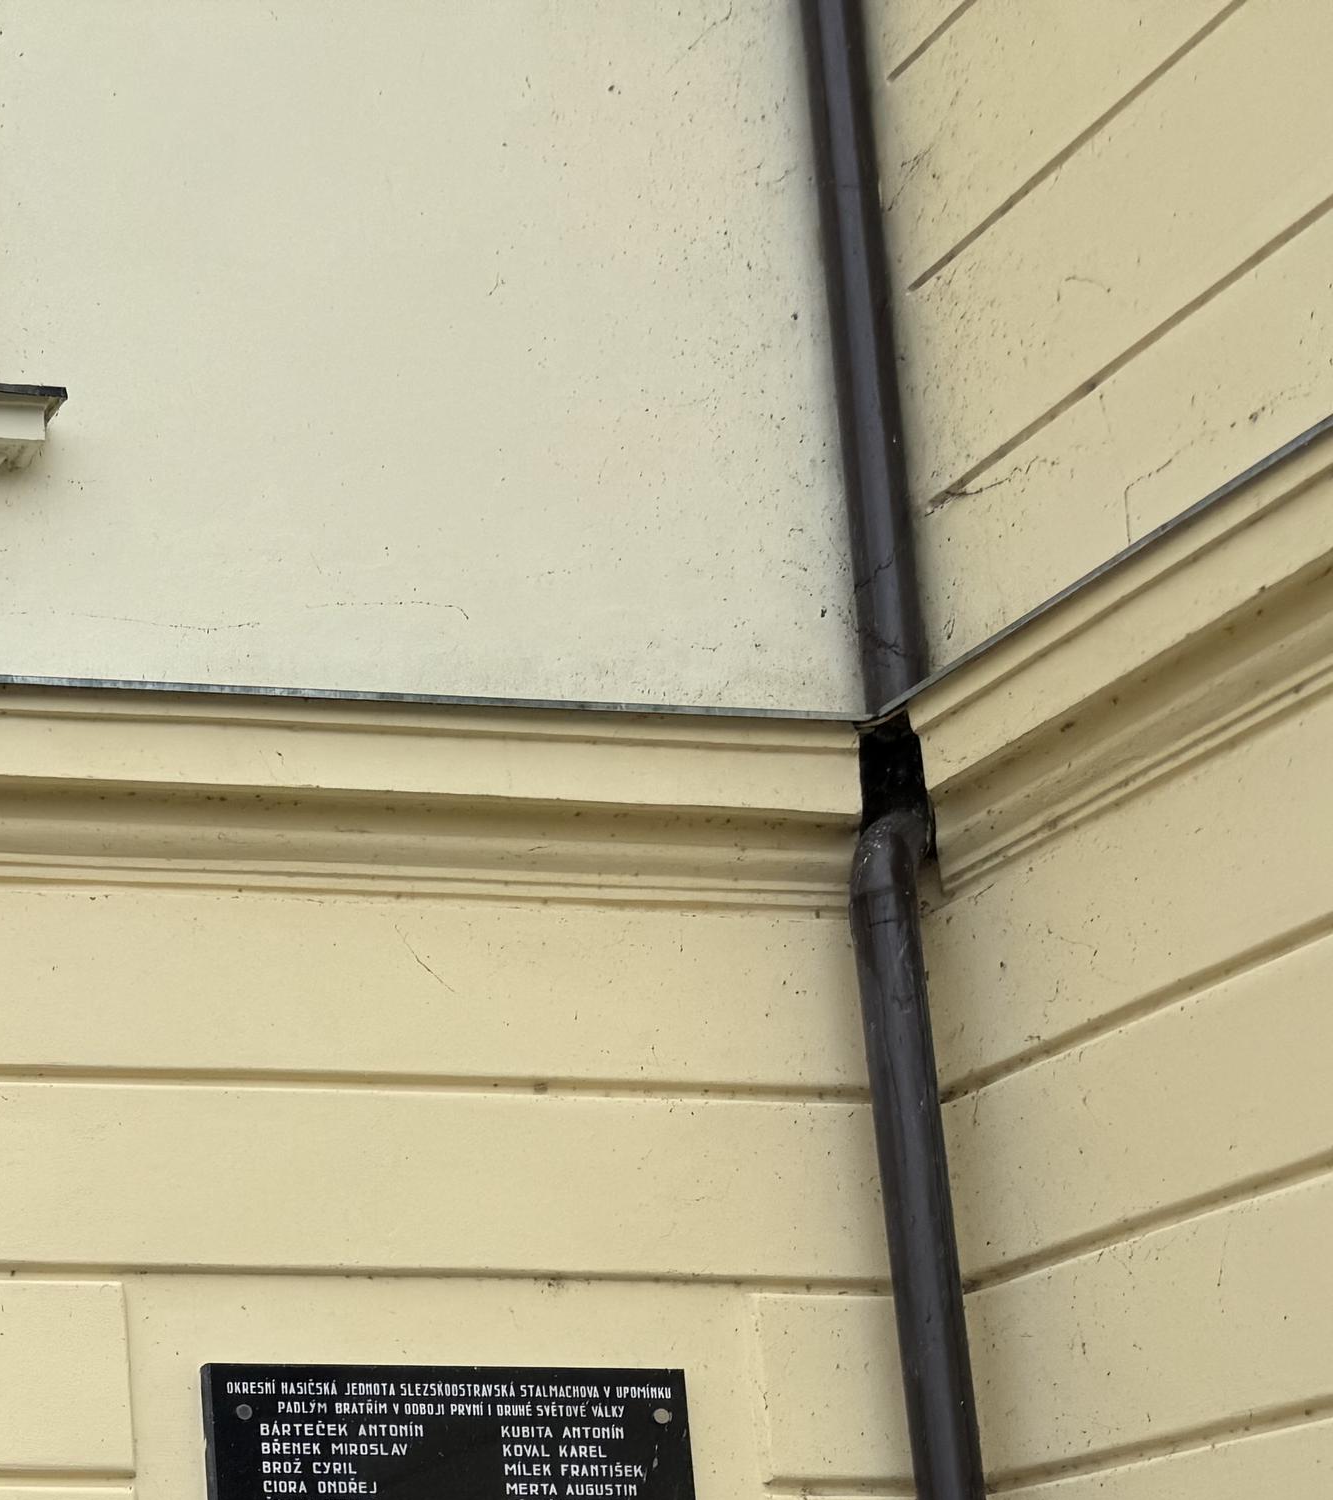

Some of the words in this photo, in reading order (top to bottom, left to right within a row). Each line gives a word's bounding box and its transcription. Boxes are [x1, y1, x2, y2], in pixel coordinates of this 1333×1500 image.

[226, 1379, 276, 1395] OKRESNÍ
[280, 1378, 338, 1396] HASIČSKÁ
[344, 1382, 396, 1396] JEDNOTA
[519, 1384, 600, 1399] STALMACHOVA
[603, 1385, 611, 1398] V
[615, 1383, 672, 1399] UPOMÍNKU
[277, 1399, 328, 1414] PADLÝM
[334, 1398, 388, 1415] BRATŘÍM
[392, 1402, 400, 1415] V
[404, 1402, 445, 1416] ODBOJI
[450, 1401, 484, 1417] PRVNÍ
[487, 1404, 492, 1416] I
[496, 1401, 533, 1417] DRUHÉ
[536, 1401, 588, 1418] SVĚTOVÉ
[591, 1402, 625, 1418] VÁLKY
[259, 1420, 348, 1437] BÁRTEČEK
[358, 1421, 424, 1438] ANTONÍN
[500, 1425, 553, 1439] KUBITA
[562, 1424, 625, 1440] ANTONÍN
[261, 1438, 321, 1455] BŘENEK
[331, 1442, 408, 1456] MIROSLAV
[502, 1443, 550, 1458] KOVAL
[558, 1444, 607, 1458] KAREL
[262, 1457, 303, 1474] BROŽ
[312, 1461, 357, 1475] CYRIL
[504, 1461, 552, 1477] MÍLEK
[560, 1461, 644, 1478] FRANTIŠEK
[263, 1480, 307, 1494] CIORA
[317, 1477, 377, 1494] ONDŘEJ
[505, 1482, 558, 1496] MERTA
[565, 1483, 638, 1497] AUGUSTIN
